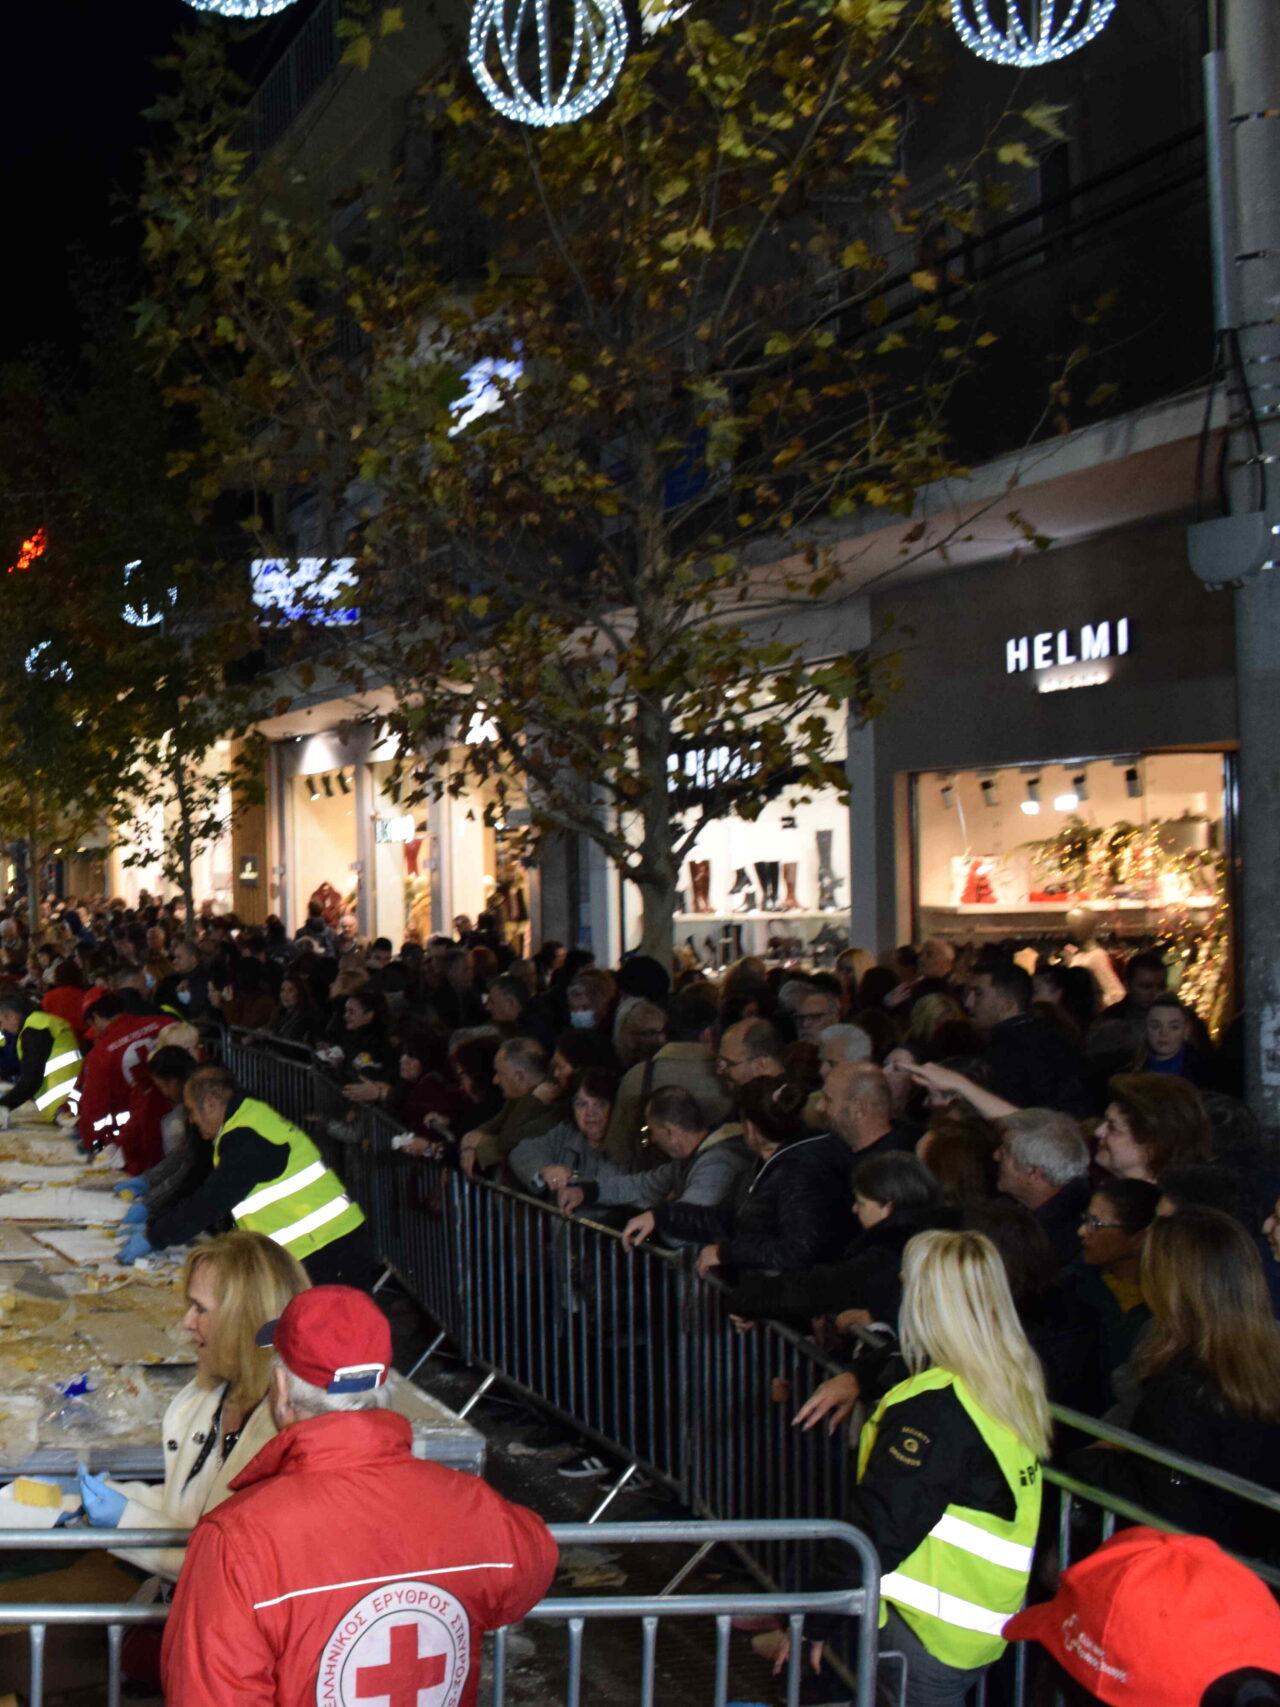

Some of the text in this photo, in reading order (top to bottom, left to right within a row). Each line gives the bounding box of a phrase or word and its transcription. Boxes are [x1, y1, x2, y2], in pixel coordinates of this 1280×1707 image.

[1006, 617, 1129, 674] HELMI
[323, 1589, 467, 1707] ΕΛΛΗΝΙΚΟΣ ΕΡΥΘΡΟΣ ΣΤΑΥΡΟΣ
